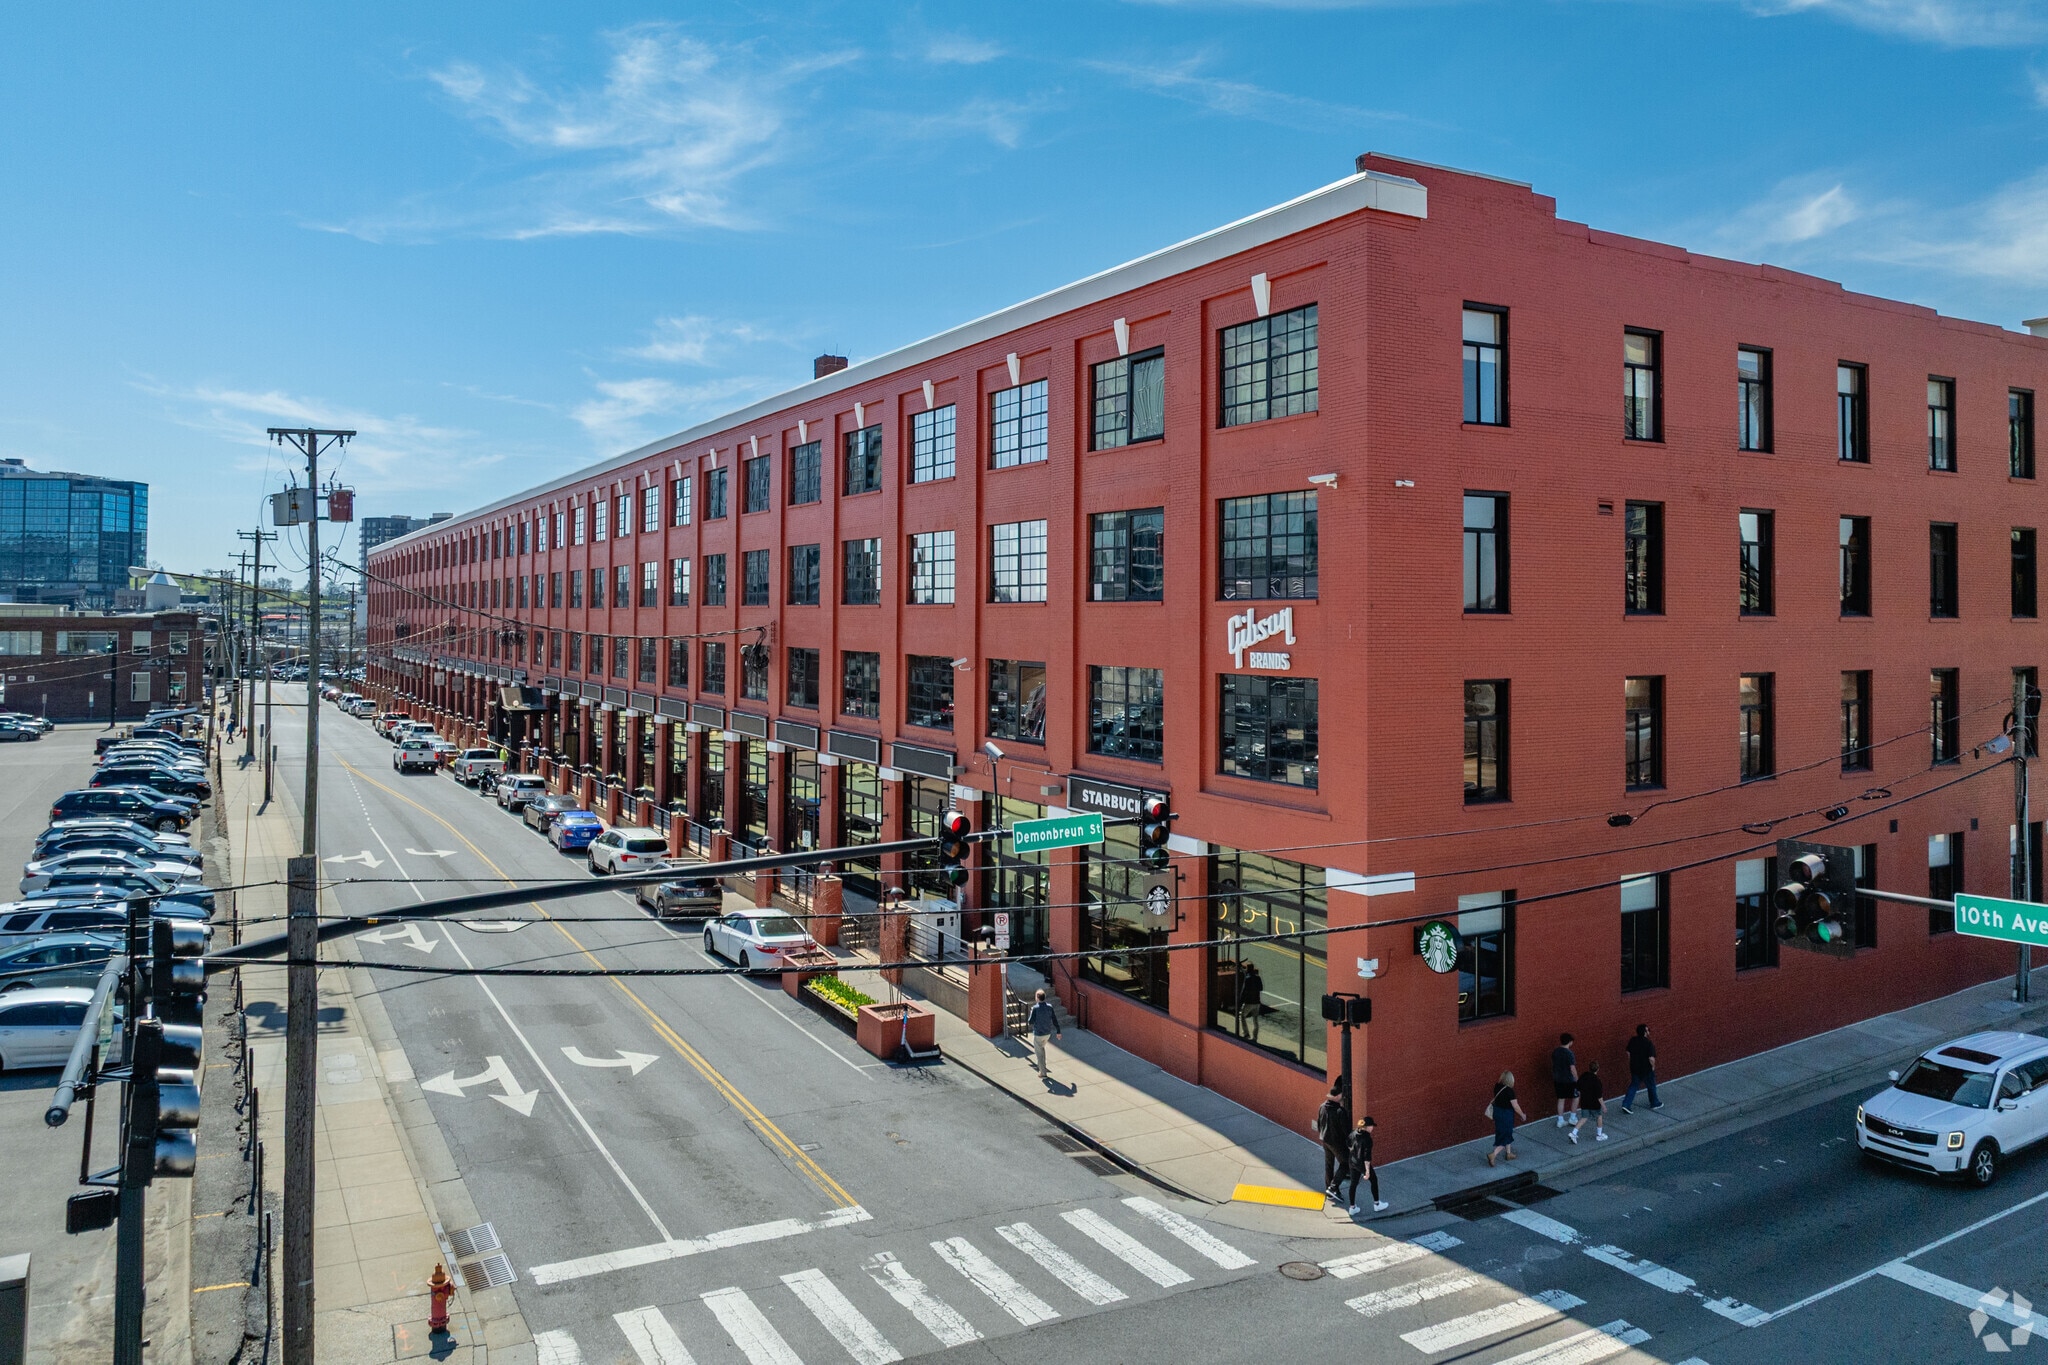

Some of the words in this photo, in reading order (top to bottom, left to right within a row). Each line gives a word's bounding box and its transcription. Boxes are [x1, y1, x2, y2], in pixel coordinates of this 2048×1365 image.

[1228, 607, 1296, 669] Gibson
[1249, 651, 1291, 670] BRANDS
[1082, 788, 1140, 814] STARBUCK
[1016, 824, 1084, 845] Demonbreun
[1089, 823, 1101, 835] St
[1960, 906, 2004, 928] 10th
[2011, 913, 2048, 935] Ave
